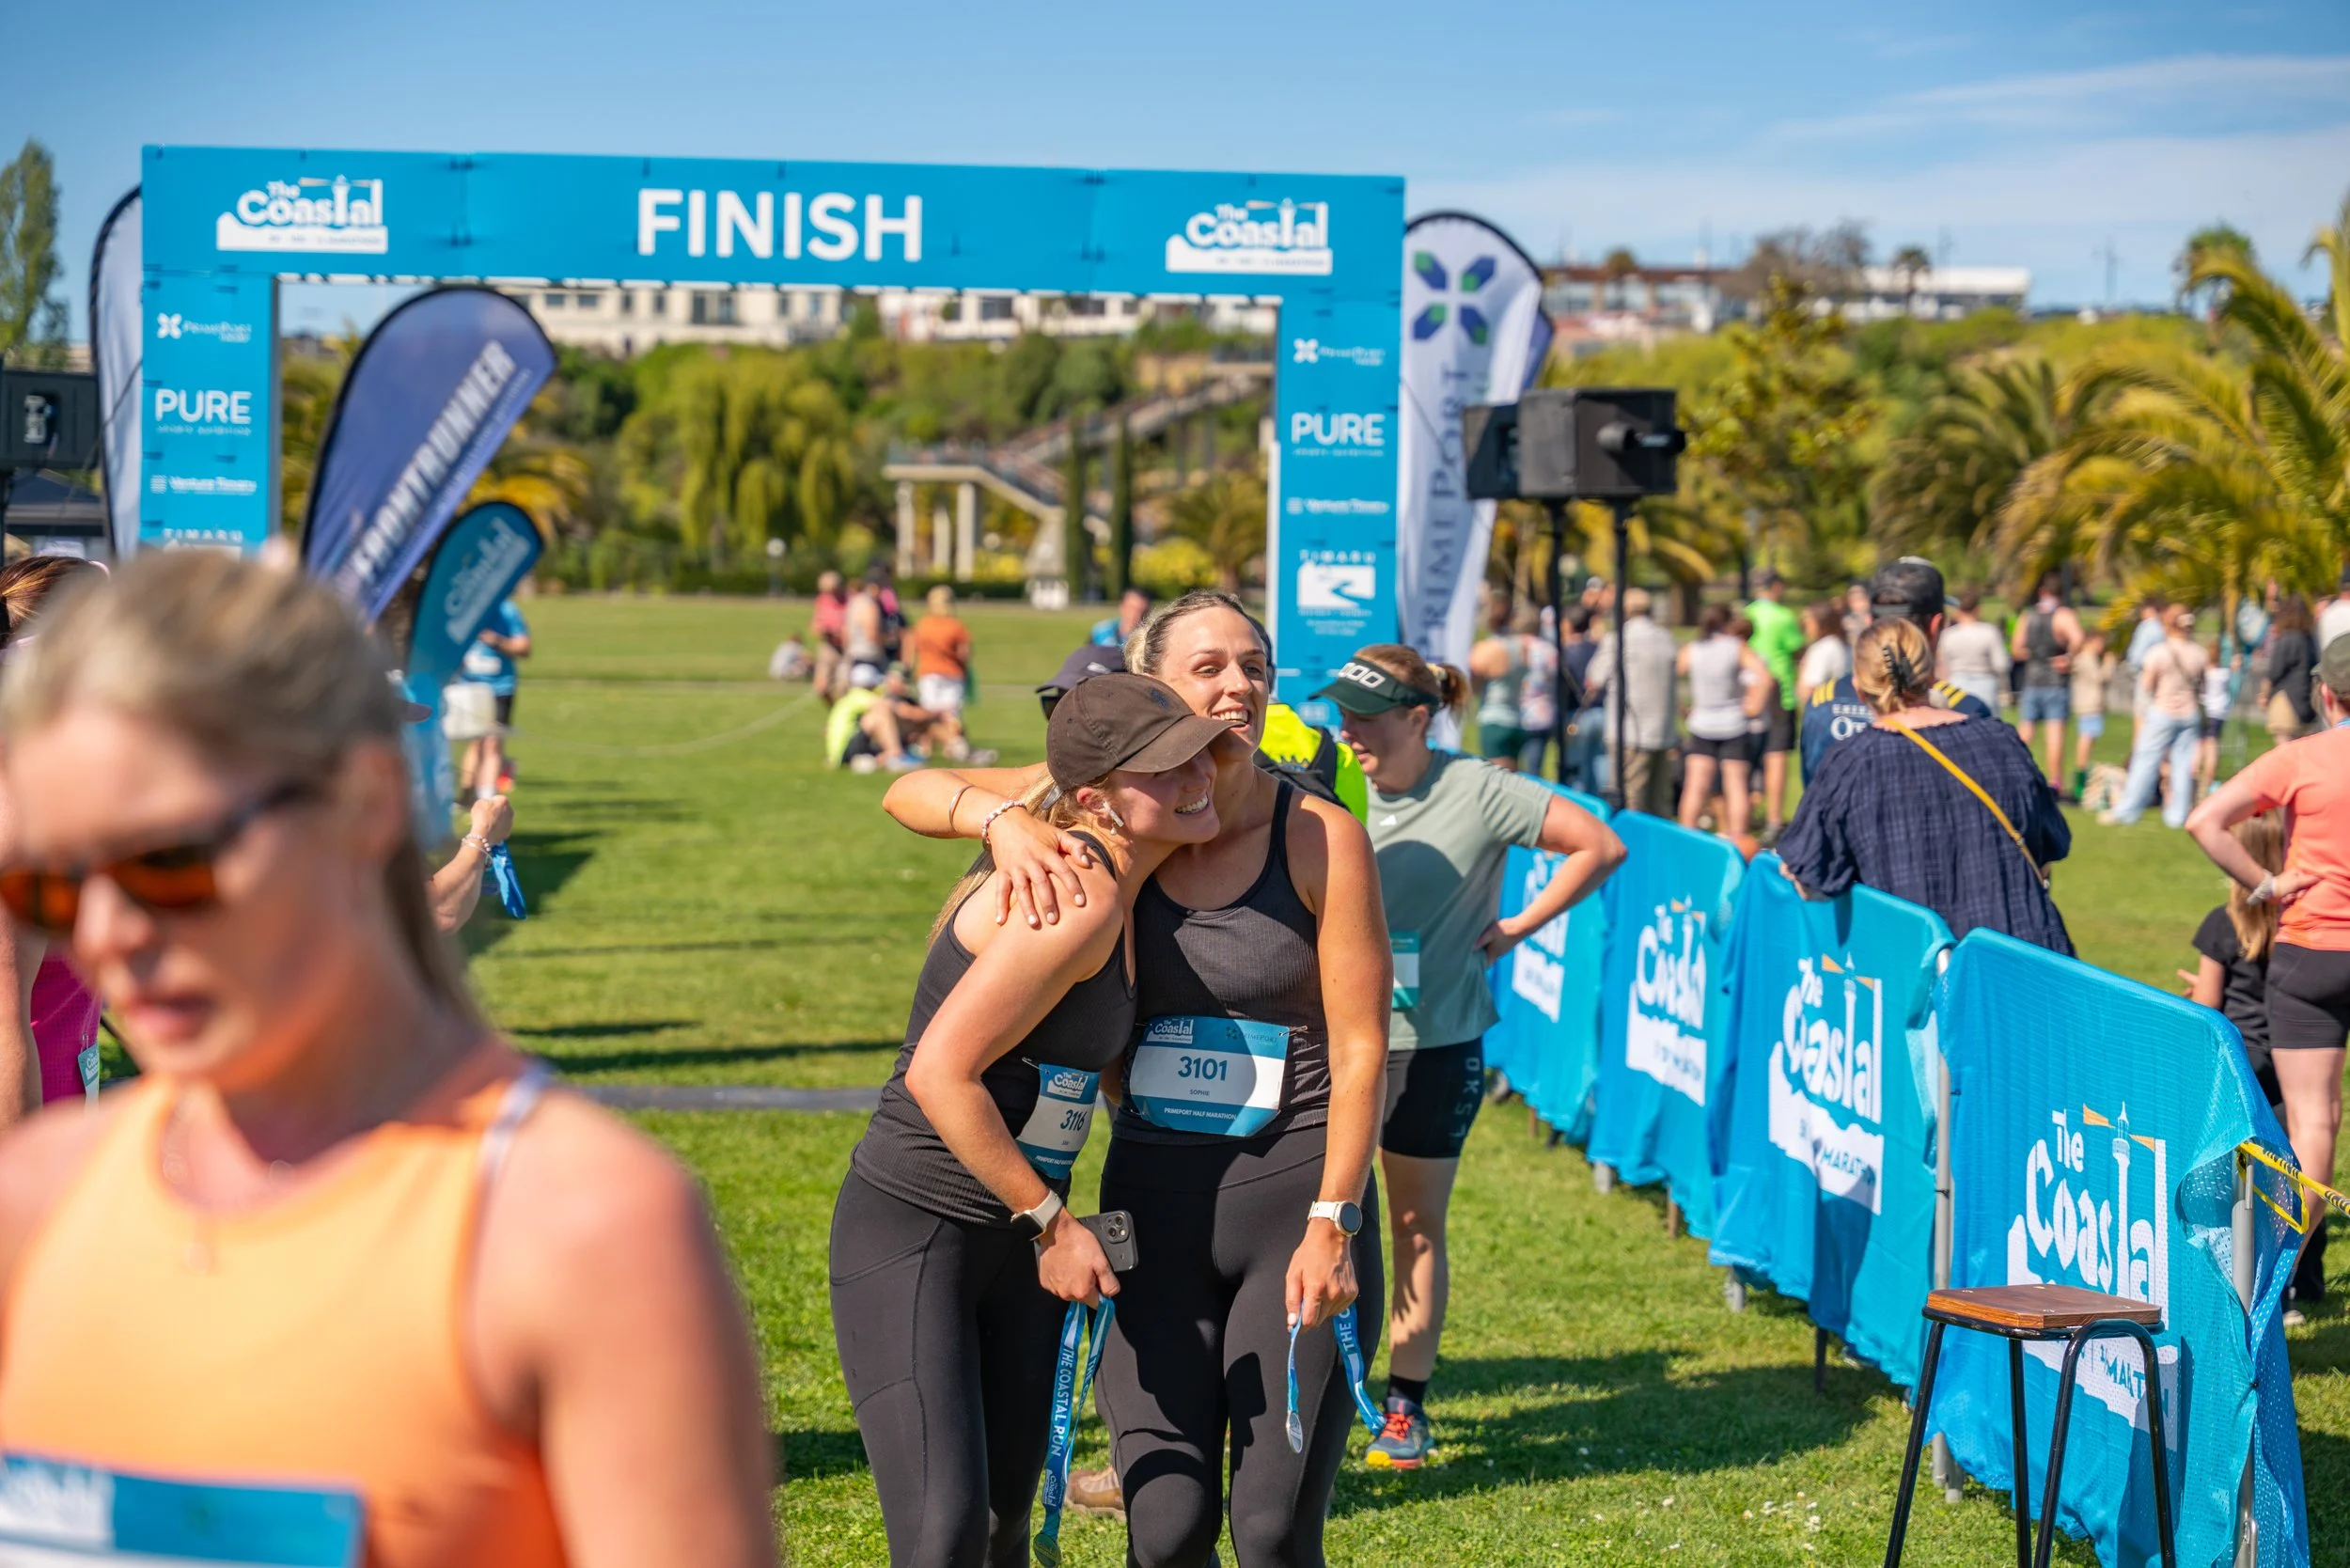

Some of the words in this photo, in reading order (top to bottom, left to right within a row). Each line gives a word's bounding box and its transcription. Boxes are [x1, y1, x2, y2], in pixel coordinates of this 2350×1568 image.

[237, 176, 384, 226] Coastal
[638, 188, 923, 262] FINISH
[1185, 198, 1329, 248] Coastal
[155, 388, 253, 425] PURE
[1291, 412, 1386, 447] PURE
[1797, 956, 1824, 1009] The
[1154, 1018, 1194, 1035] Coastal
[1054, 1074, 1089, 1090] Coastal
[1178, 1056, 1228, 1081] 3101
[1059, 1108, 1088, 1132] 3116
[1164, 1106, 1193, 1116] PRIMEPORT
[1193, 1109, 1206, 1118] HALF
[1205, 1111, 1237, 1121] MARATHON
[2052, 1108, 2085, 1173] The
[2026, 1138, 2170, 1331] Coastal
[1339, 1322, 1355, 1352] THE
[1060, 1346, 1074, 1369] THE
[1053, 1367, 1073, 1424] COASTAL
[1049, 1423, 1067, 1458] RUN
